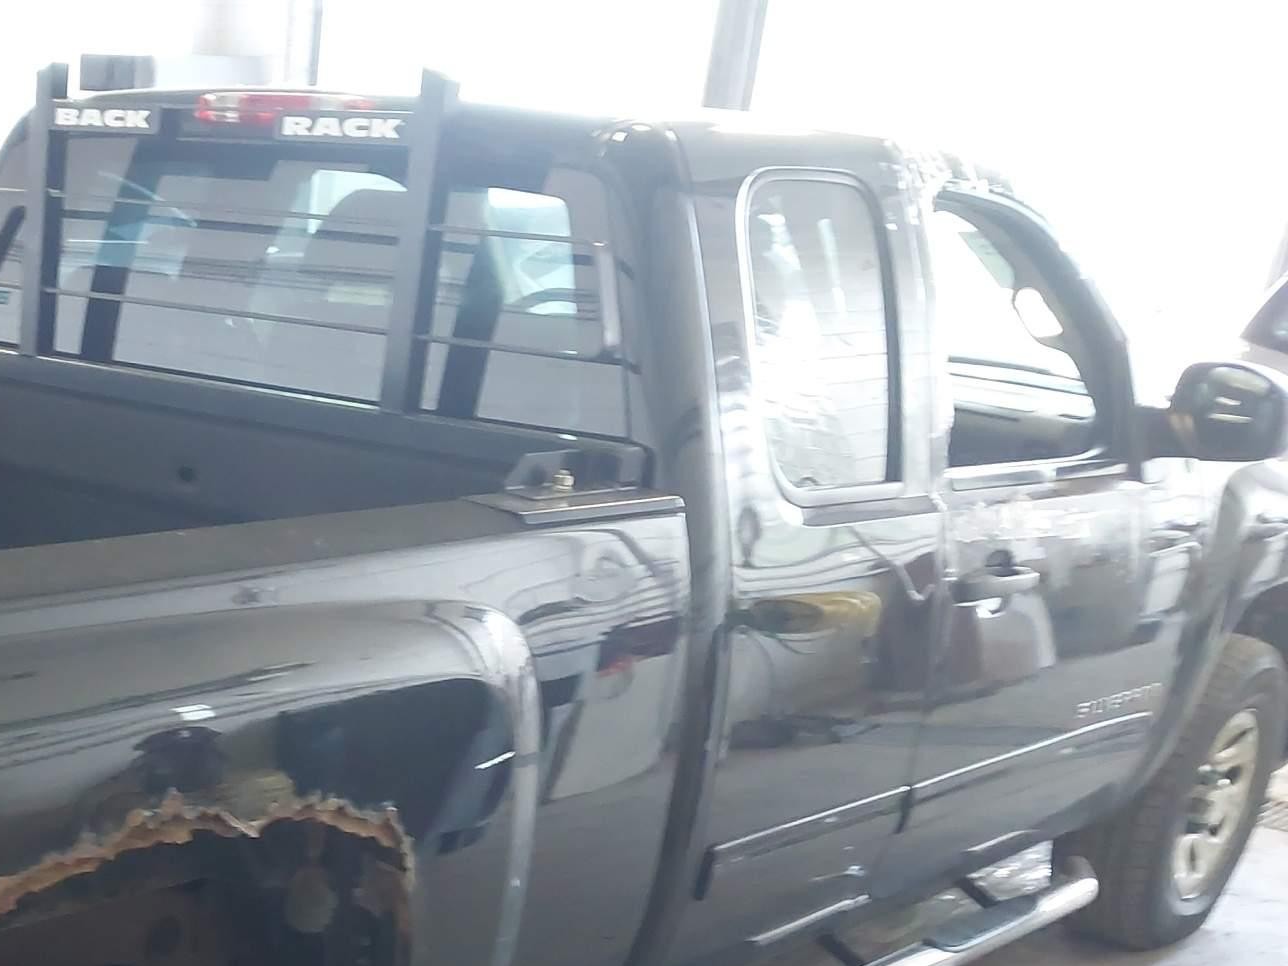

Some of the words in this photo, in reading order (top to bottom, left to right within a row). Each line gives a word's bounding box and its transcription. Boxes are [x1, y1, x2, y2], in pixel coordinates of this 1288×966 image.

[54, 107, 153, 129] BACK
[280, 115, 403, 139] RACK
[1076, 681, 1163, 719] SILVER
